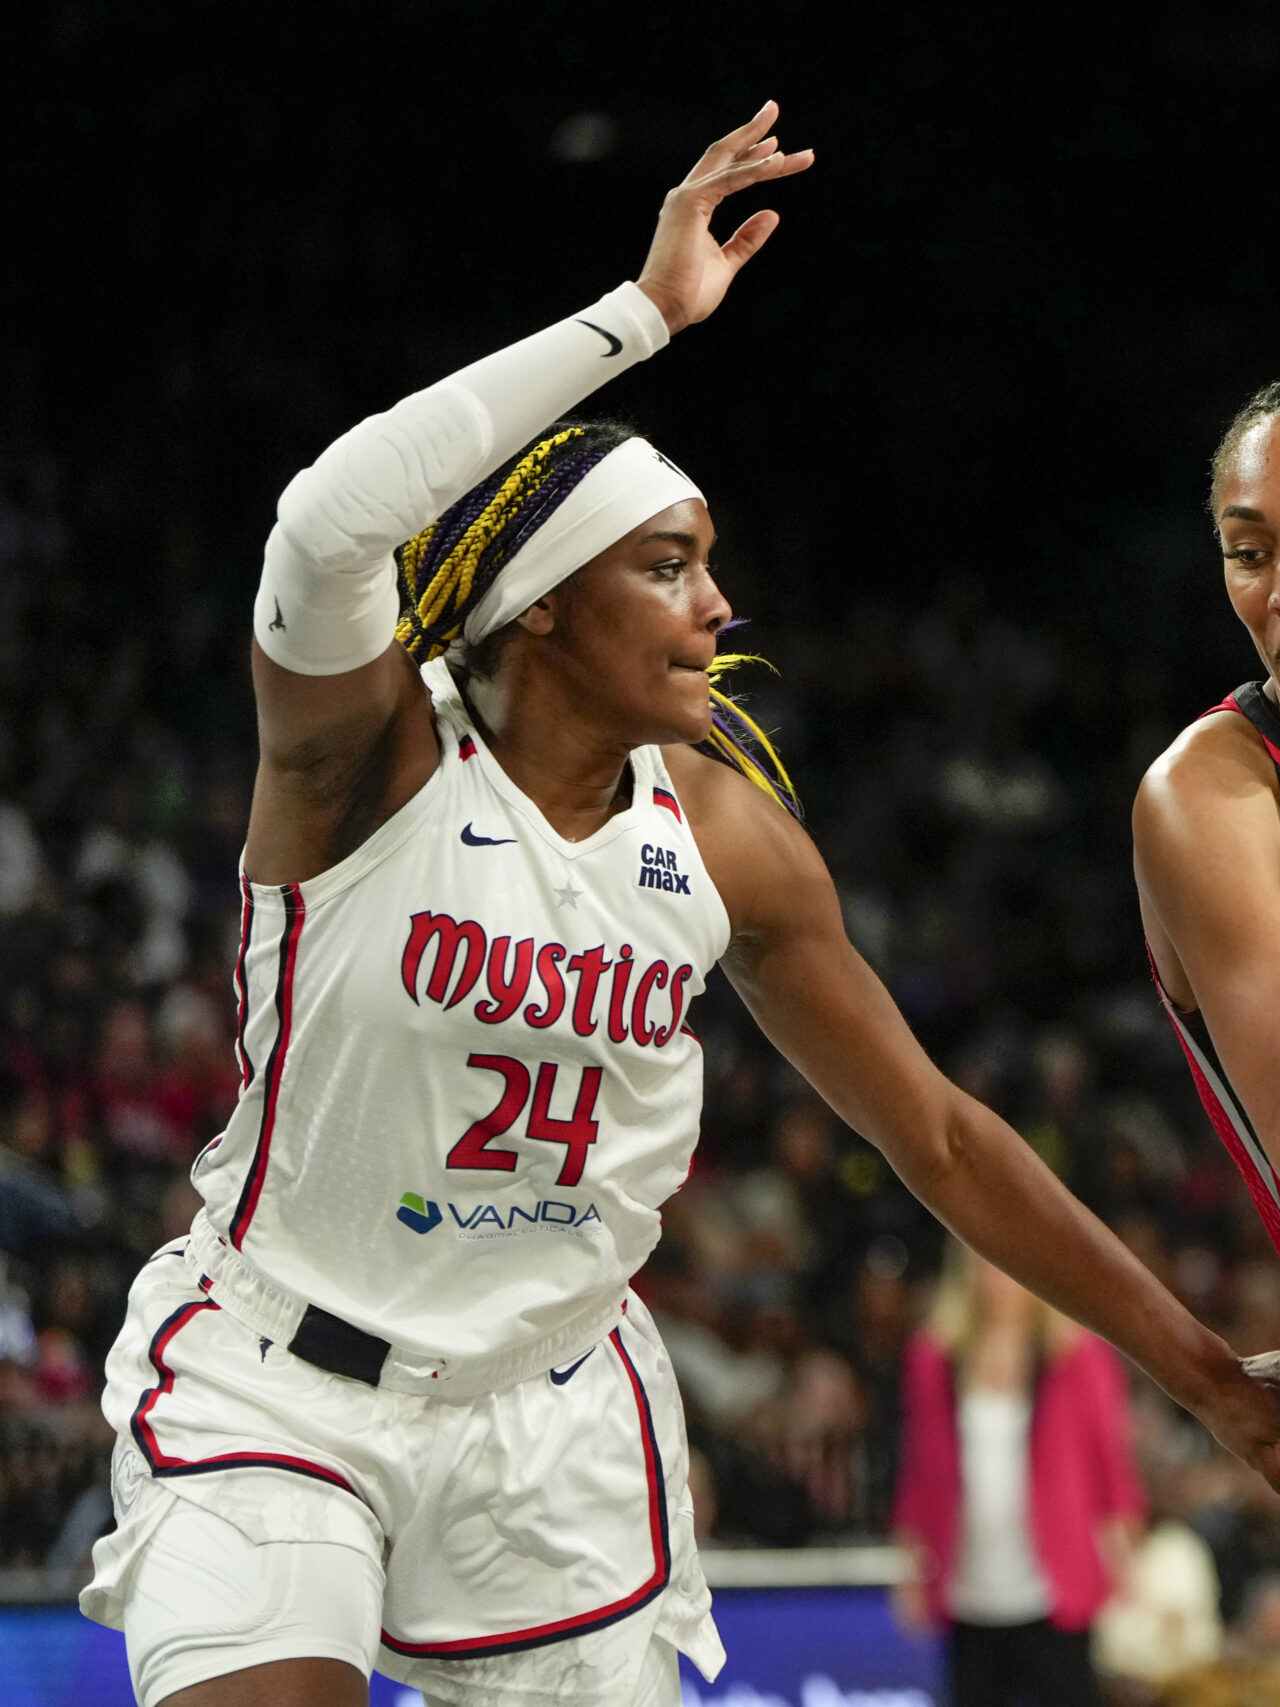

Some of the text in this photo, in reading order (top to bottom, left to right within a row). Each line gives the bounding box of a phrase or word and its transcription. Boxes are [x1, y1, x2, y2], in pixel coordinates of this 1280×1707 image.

[641, 843, 677, 872] CAR
[638, 865, 691, 895] max
[445, 1053, 603, 1187] 24
[447, 1200, 602, 1230] VANDA
